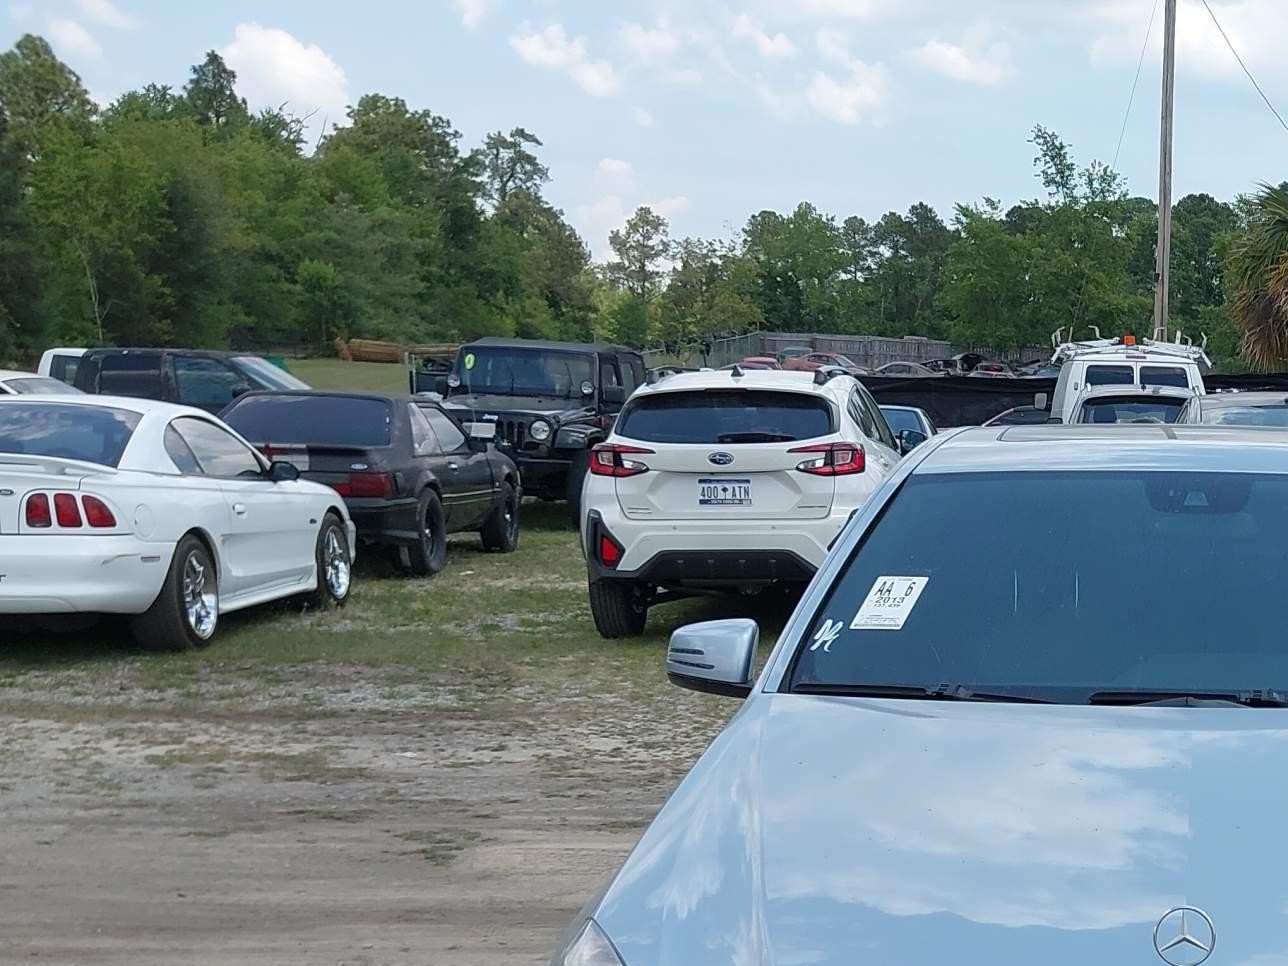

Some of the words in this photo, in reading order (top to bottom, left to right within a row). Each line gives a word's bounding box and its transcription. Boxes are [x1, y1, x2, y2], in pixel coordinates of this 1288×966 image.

[701, 486, 719, 499] 400
[731, 486, 750, 499] ATN
[873, 581, 895, 596] AA
[904, 581, 917, 597] 6
[875, 596, 906, 604] 2013
